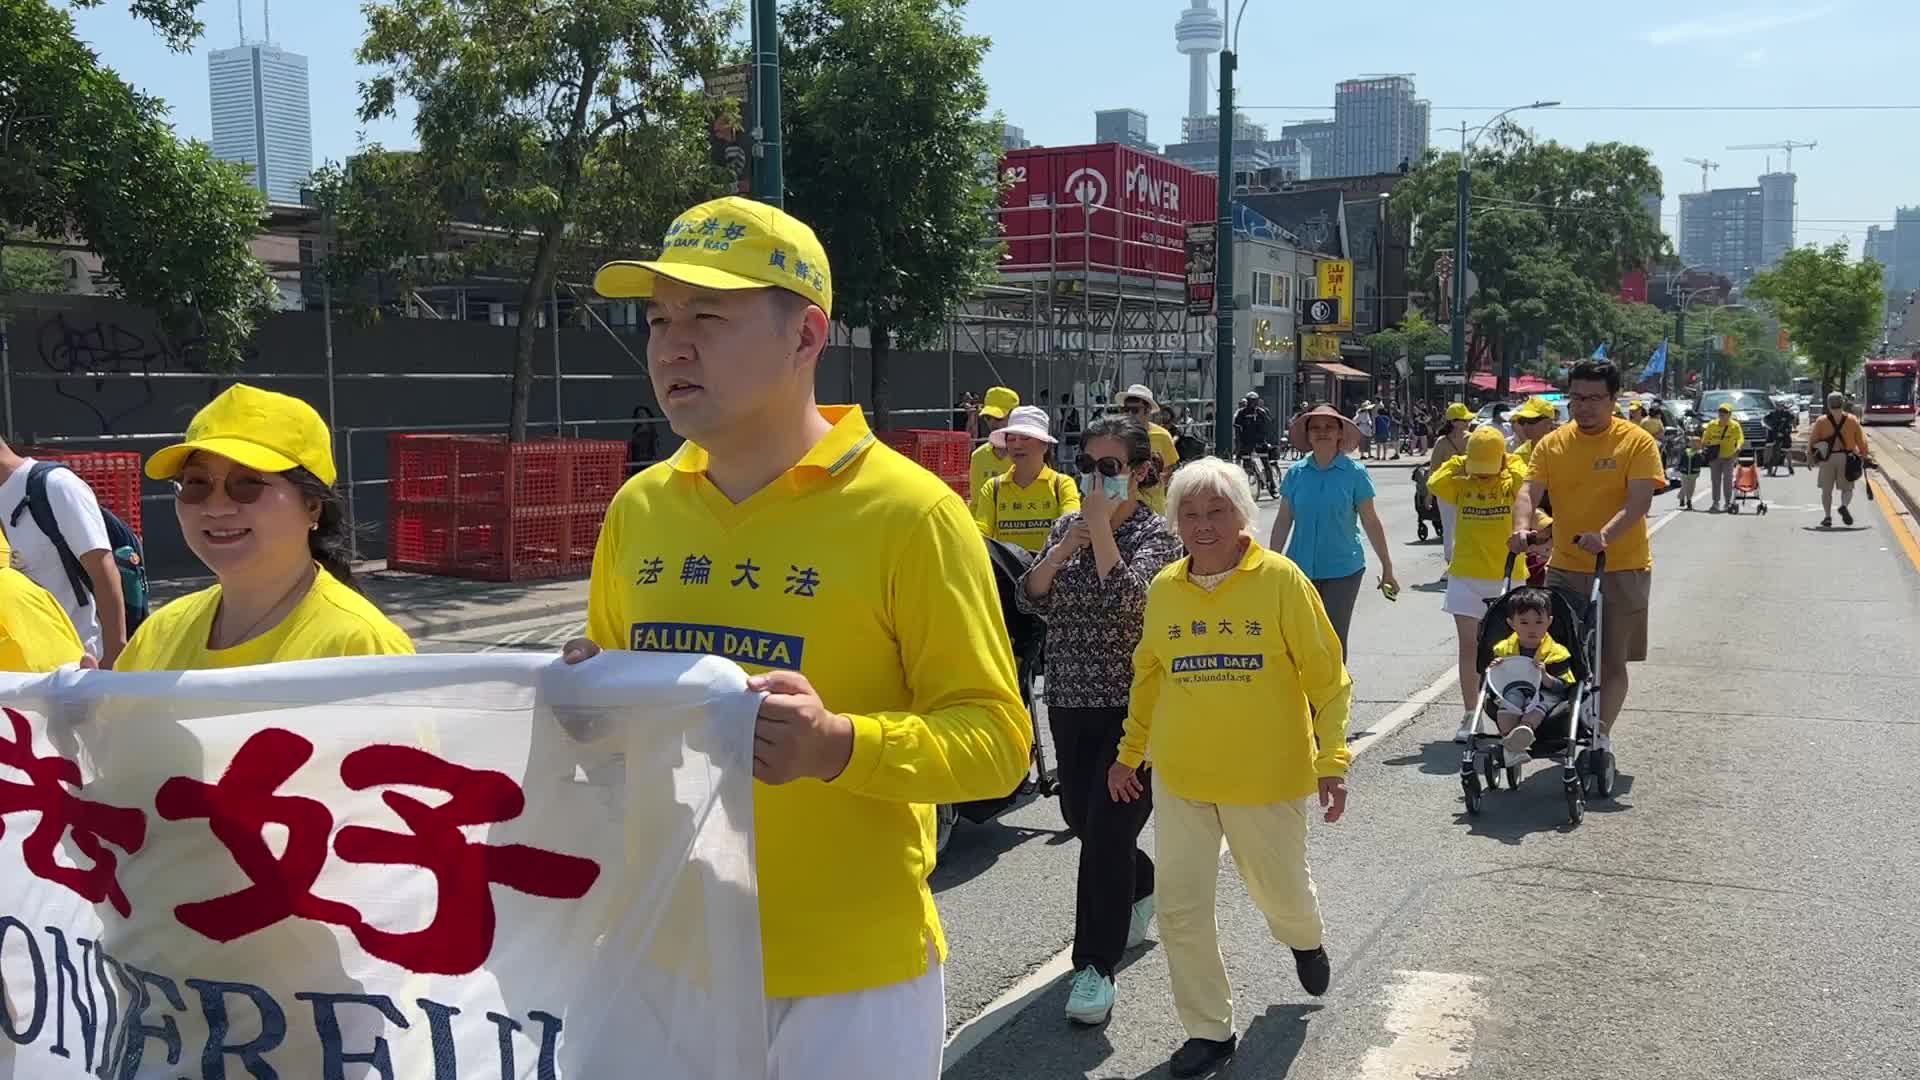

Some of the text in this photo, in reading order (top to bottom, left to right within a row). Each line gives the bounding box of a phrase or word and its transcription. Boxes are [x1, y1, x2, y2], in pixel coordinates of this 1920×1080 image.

[1126, 164, 1179, 211] POWER
[636, 553, 820, 598] 法輪大法
[633, 627, 792, 665] FALUN DAFA
[1168, 619, 1262, 640] 法輪大法
[1174, 656, 1260, 671] FALUN DAFA
